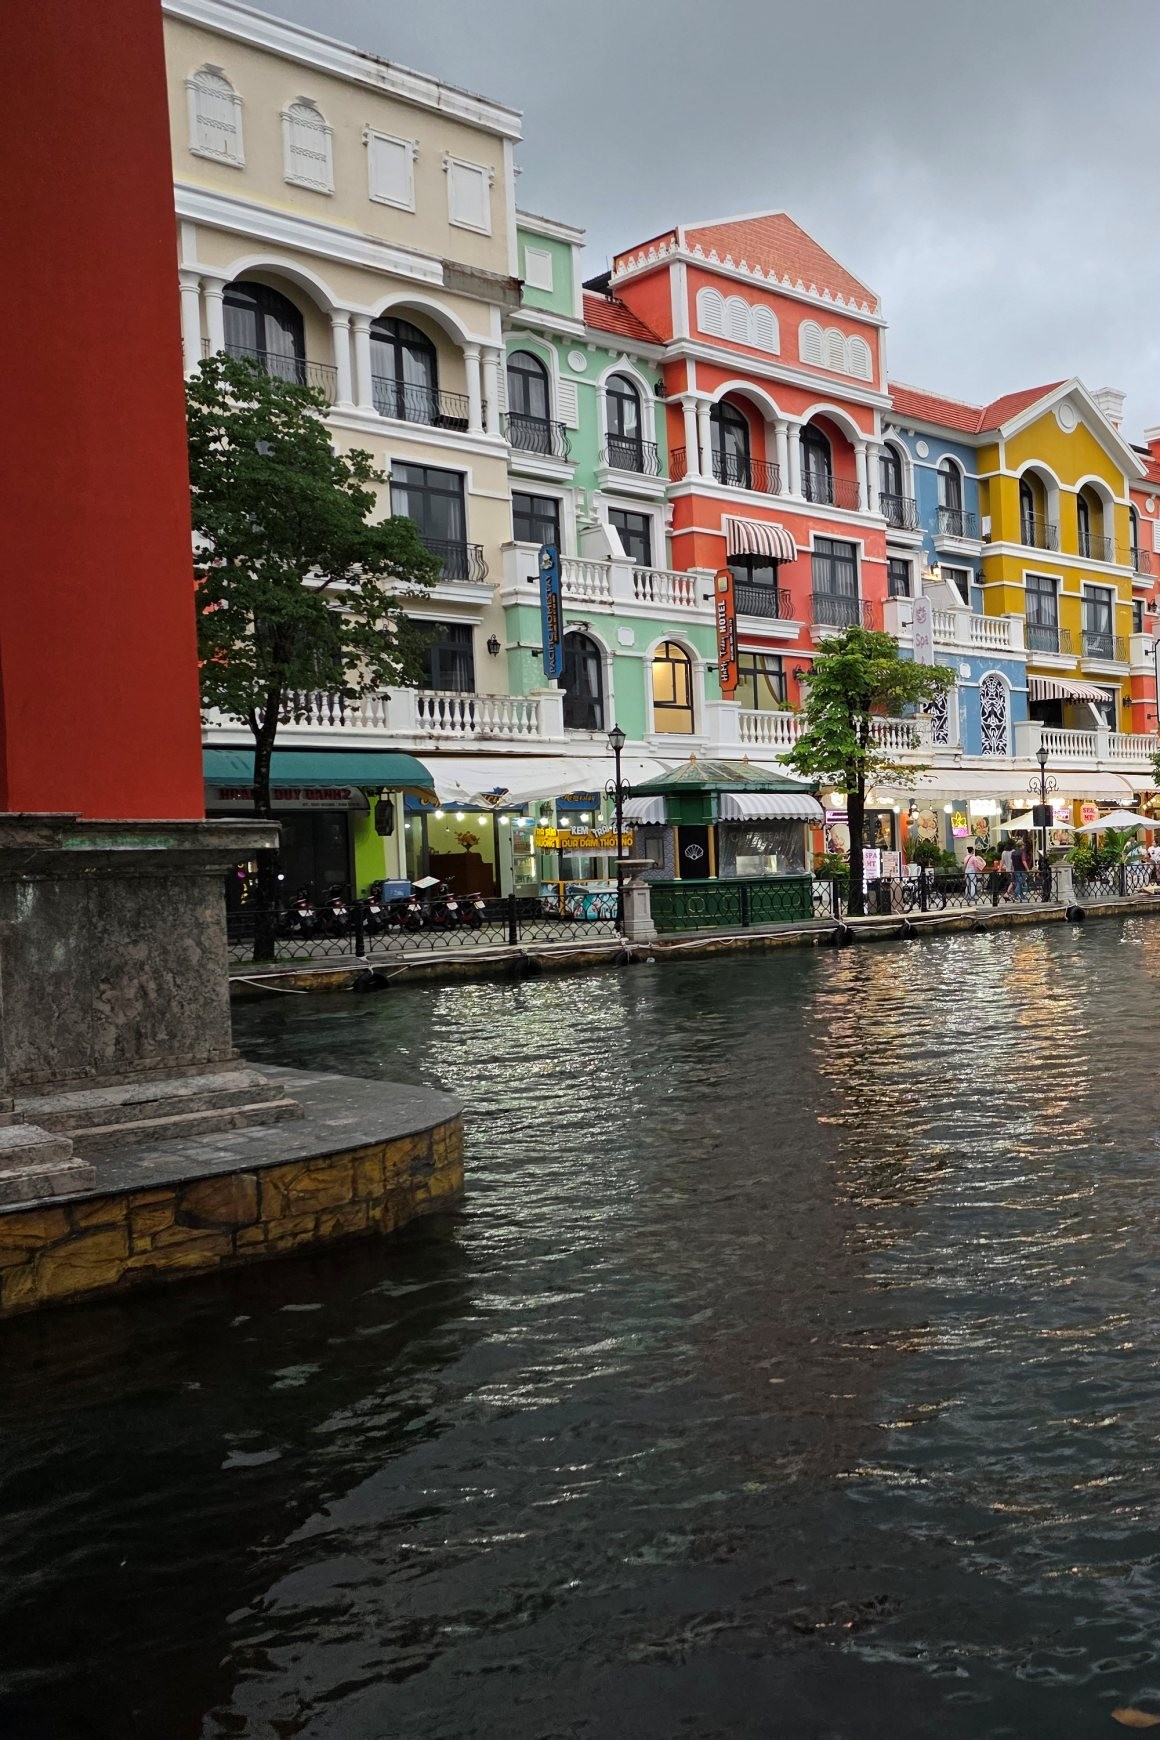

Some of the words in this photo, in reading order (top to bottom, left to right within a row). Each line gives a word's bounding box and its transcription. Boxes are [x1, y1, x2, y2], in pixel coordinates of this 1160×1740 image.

[545, 575, 553, 632] HOMESTAY
[717, 600, 726, 633] HOTEL
[915, 633, 930, 648] Spa
